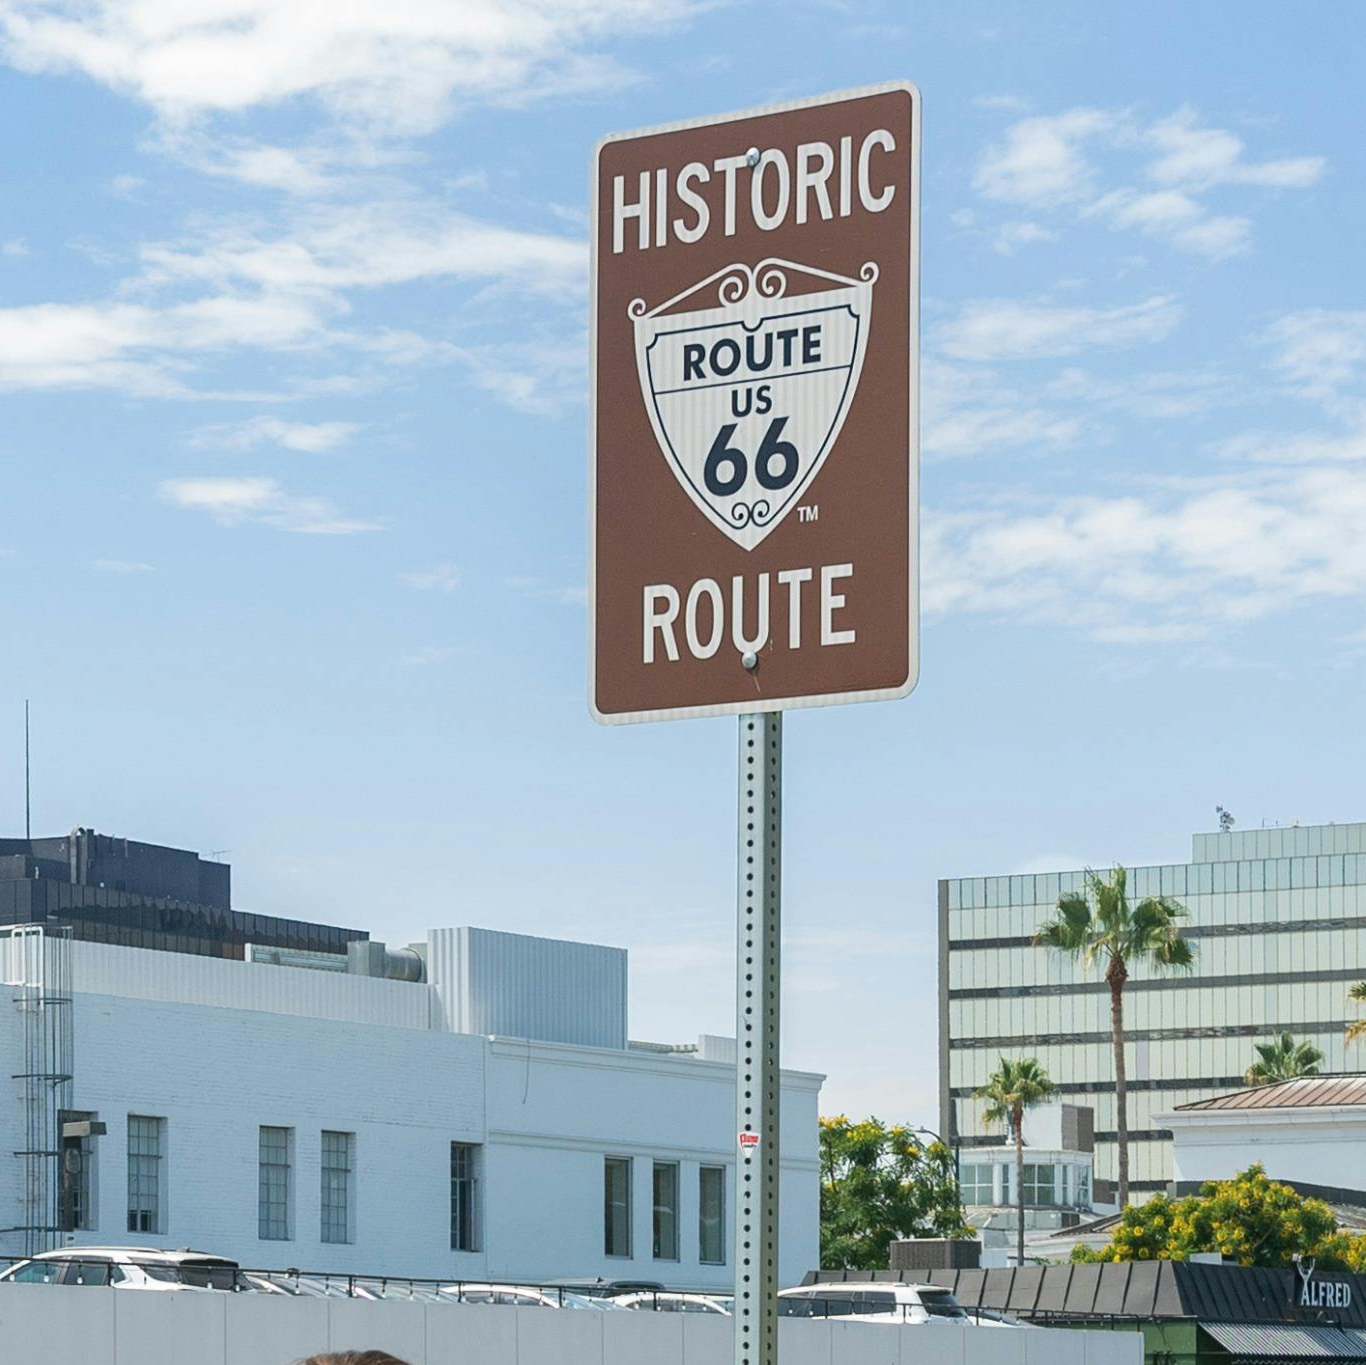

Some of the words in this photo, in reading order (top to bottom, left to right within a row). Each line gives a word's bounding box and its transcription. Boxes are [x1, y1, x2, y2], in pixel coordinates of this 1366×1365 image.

[612, 128, 897, 254] HISTORIC
[683, 324, 822, 381] ROUTE
[731, 385, 773, 418] US
[703, 416, 800, 497] 66
[797, 505, 819, 522] TM
[642, 563, 856, 664] ROUTE
[1300, 1280, 1351, 1308] ALFRED
